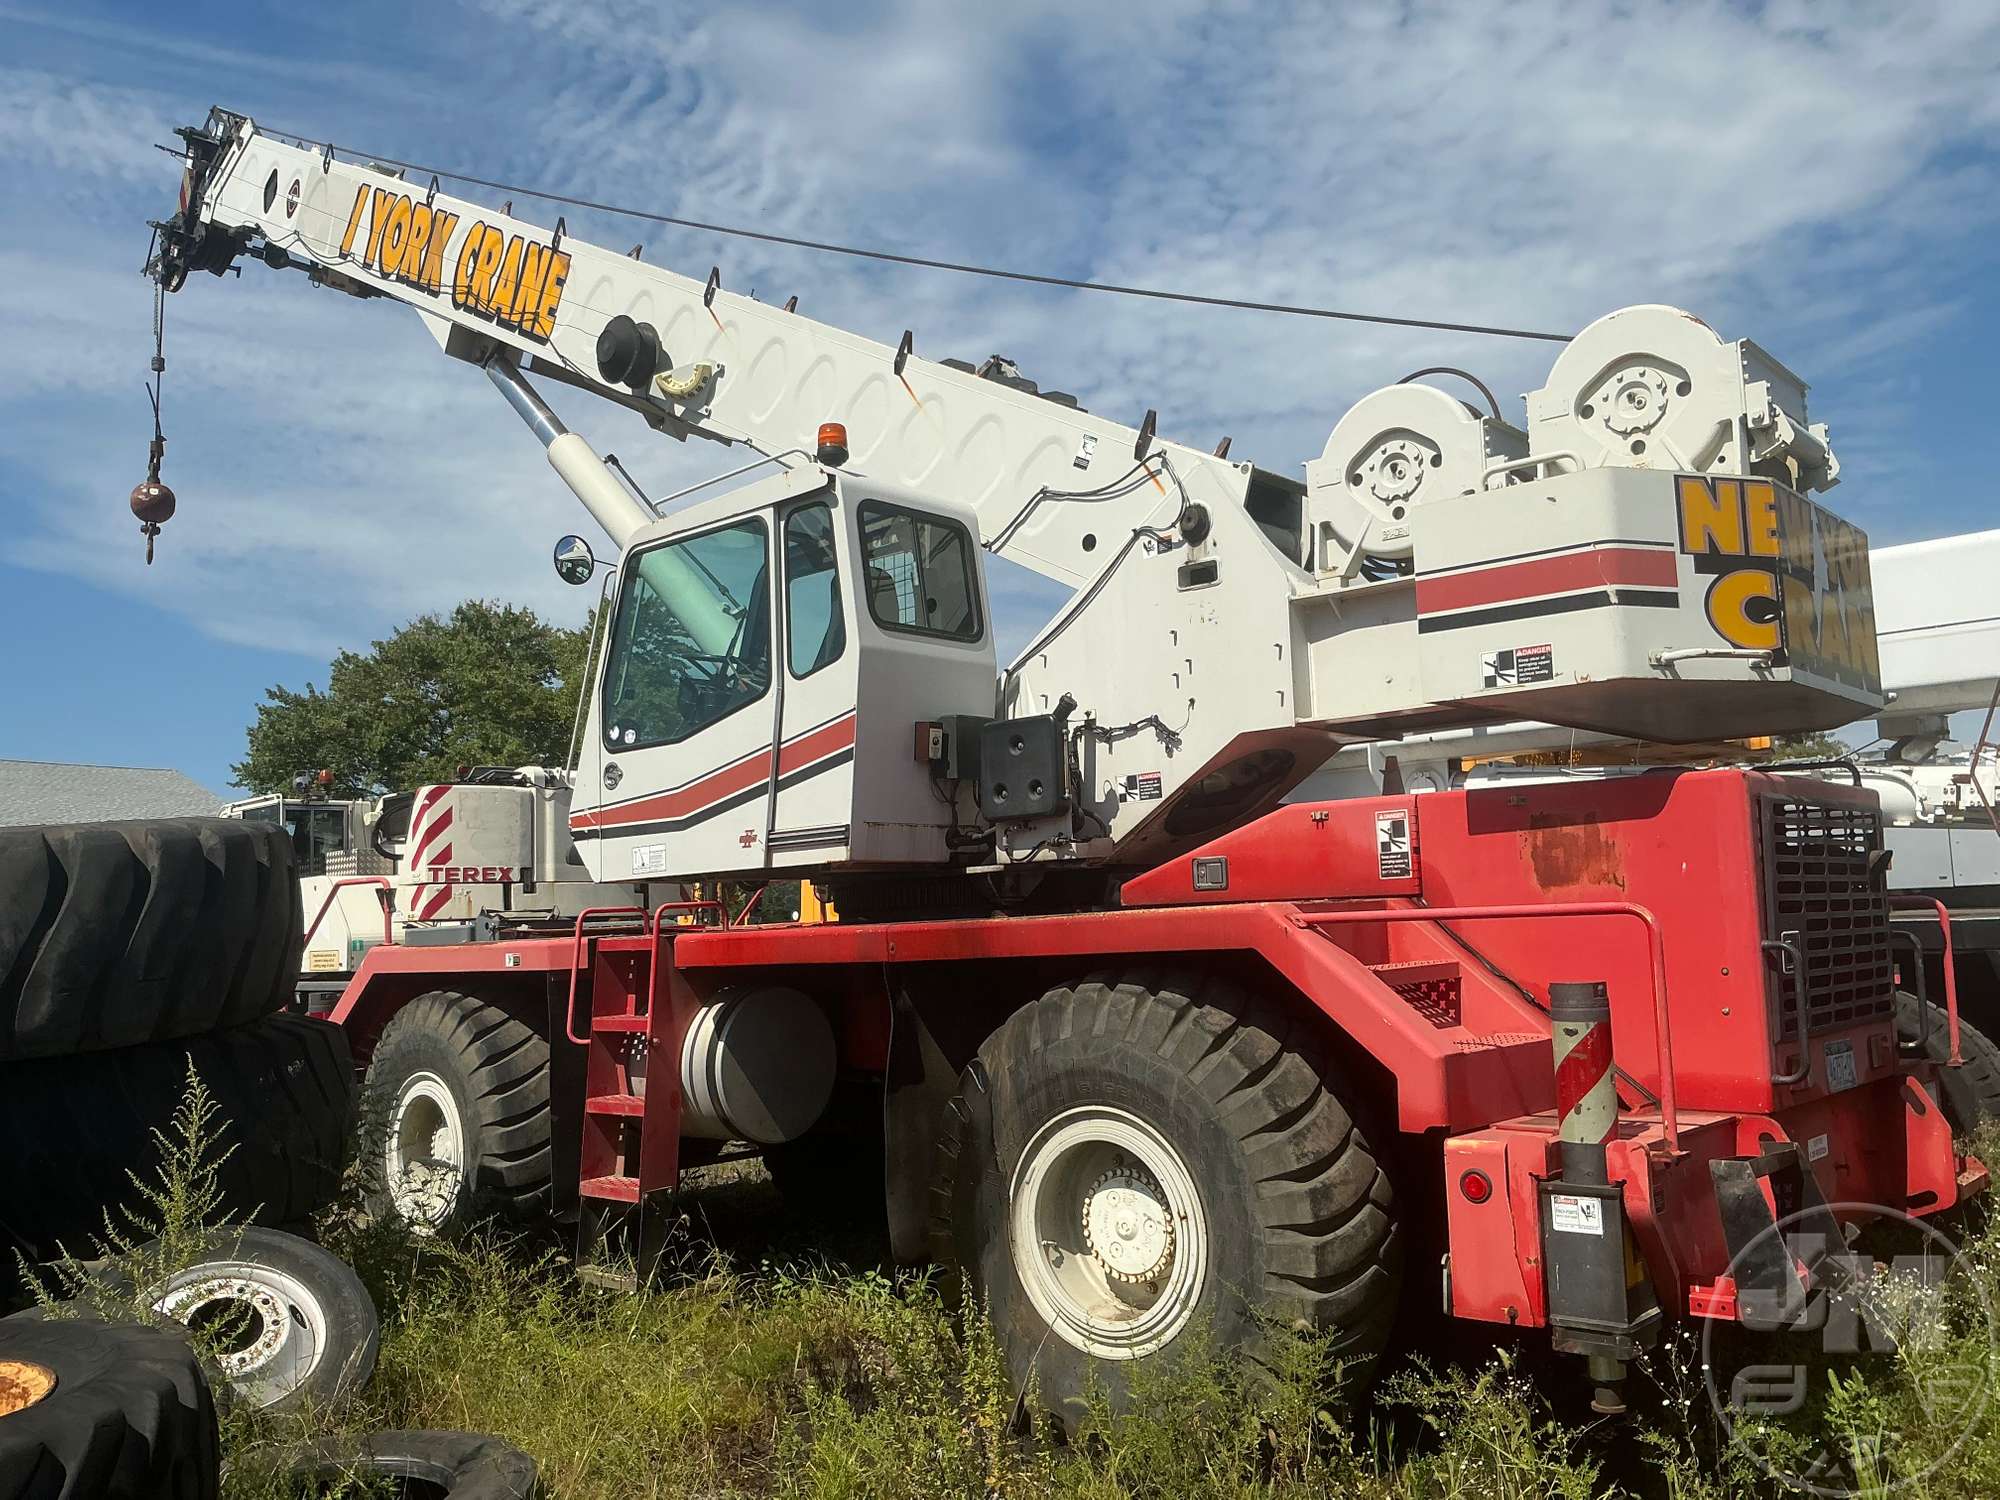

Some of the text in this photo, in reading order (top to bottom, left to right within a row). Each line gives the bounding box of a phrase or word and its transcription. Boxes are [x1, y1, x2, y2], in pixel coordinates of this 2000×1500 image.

[364, 188, 460, 298] YORK
[453, 221, 572, 345] CRANE
[1522, 646, 1551, 655] DANGER
[427, 867, 513, 882] TEREX
